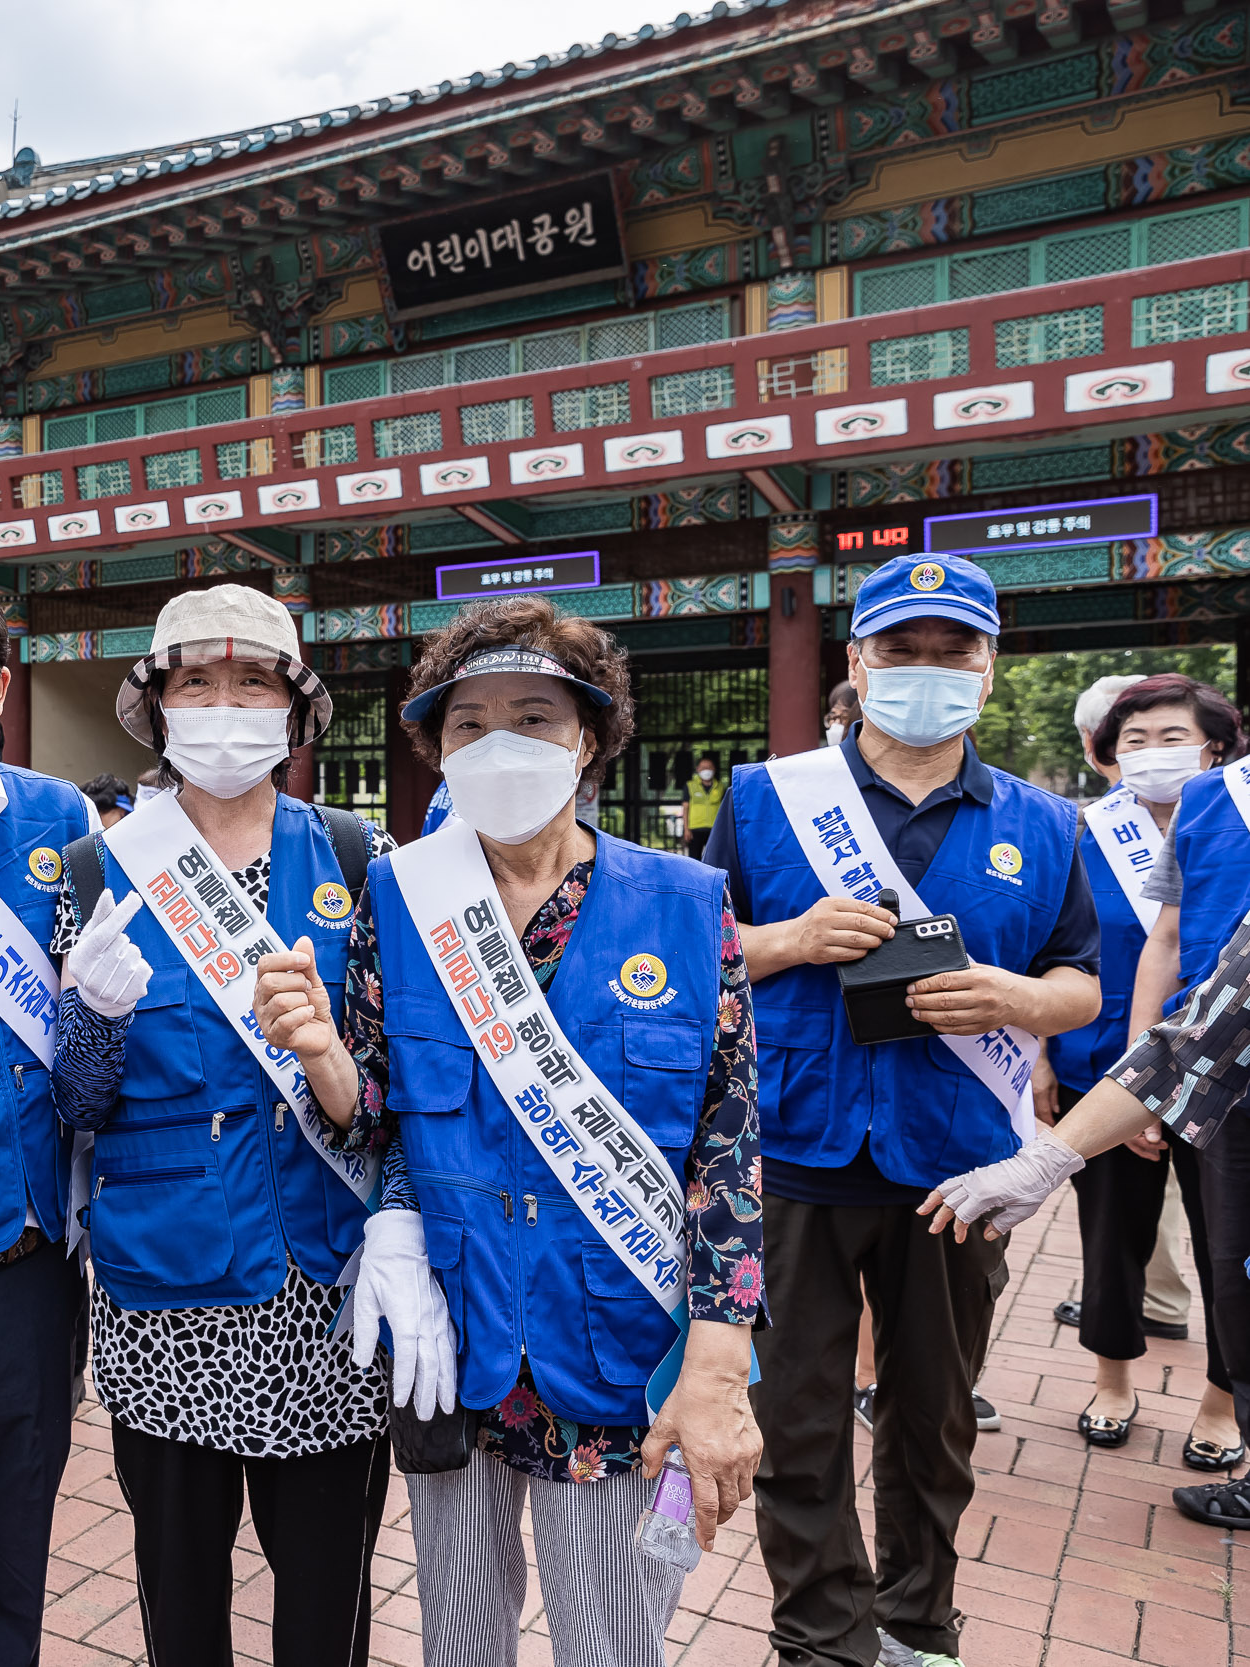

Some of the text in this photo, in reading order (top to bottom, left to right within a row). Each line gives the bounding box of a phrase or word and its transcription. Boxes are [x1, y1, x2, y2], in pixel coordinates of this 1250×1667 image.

[407, 202, 597, 277] 어린이대공원
[466, 657, 489, 670] SINCE
[516, 653, 540, 664] 1948
[812, 805, 861, 866] 법질서
[147, 871, 242, 987] 코로나19
[177, 847, 252, 936] 여름철
[429, 919, 515, 1061] 코로나19
[463, 899, 687, 1243] 여름철 행락 질서지키
